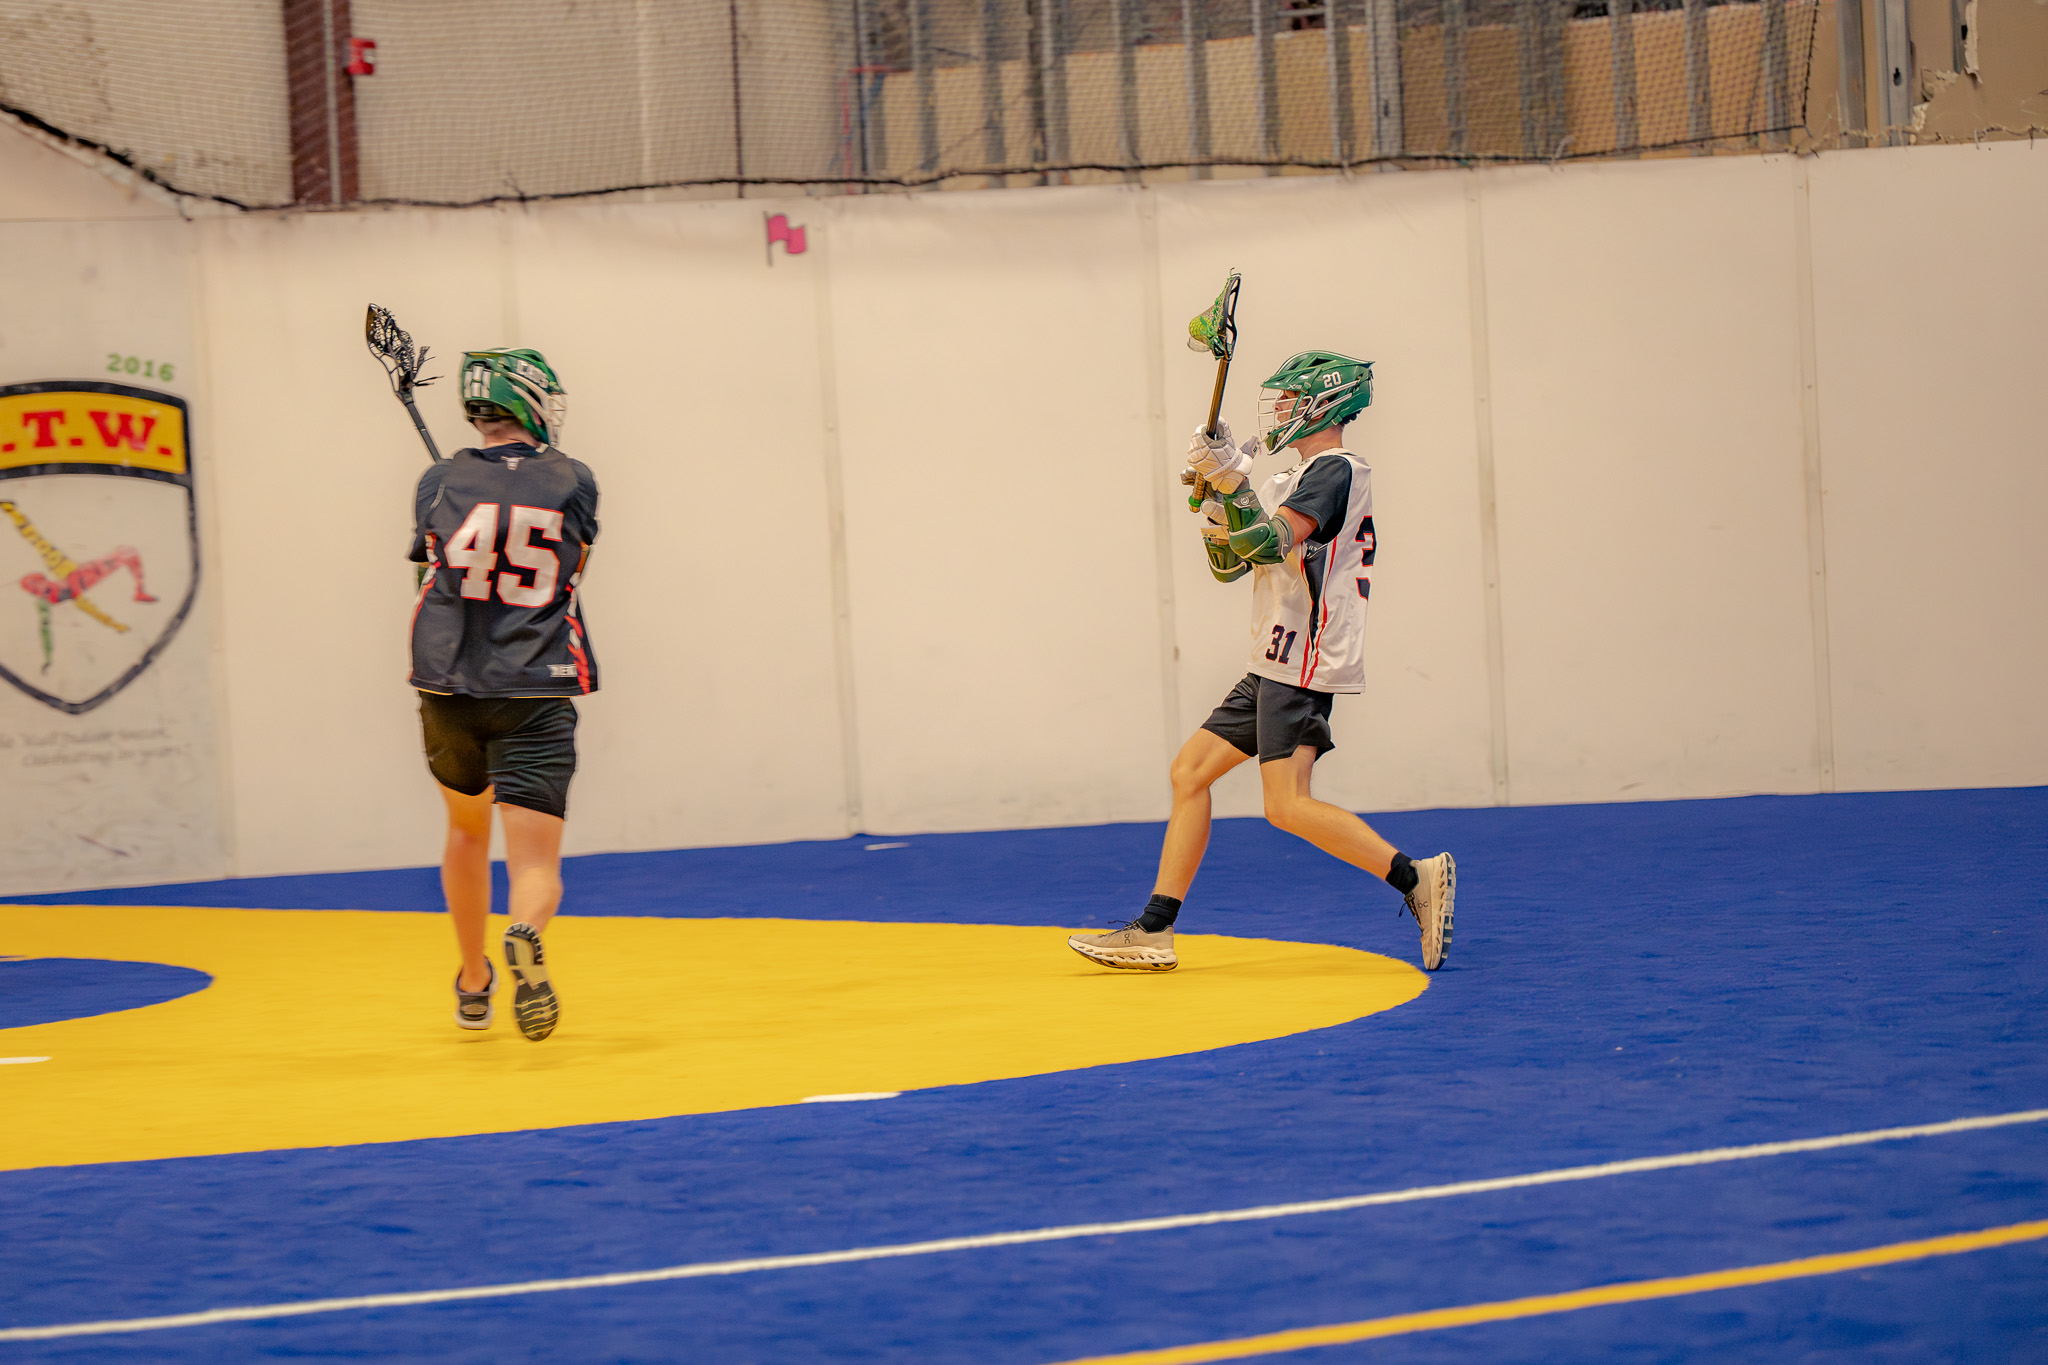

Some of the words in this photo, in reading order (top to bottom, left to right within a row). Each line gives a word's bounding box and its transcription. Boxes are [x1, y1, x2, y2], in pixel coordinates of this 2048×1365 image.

[106, 353, 176, 382] 2016
[1322, 371, 1342, 388] 20
[444, 503, 564, 608] 45
[1265, 624, 1298, 665] 31
